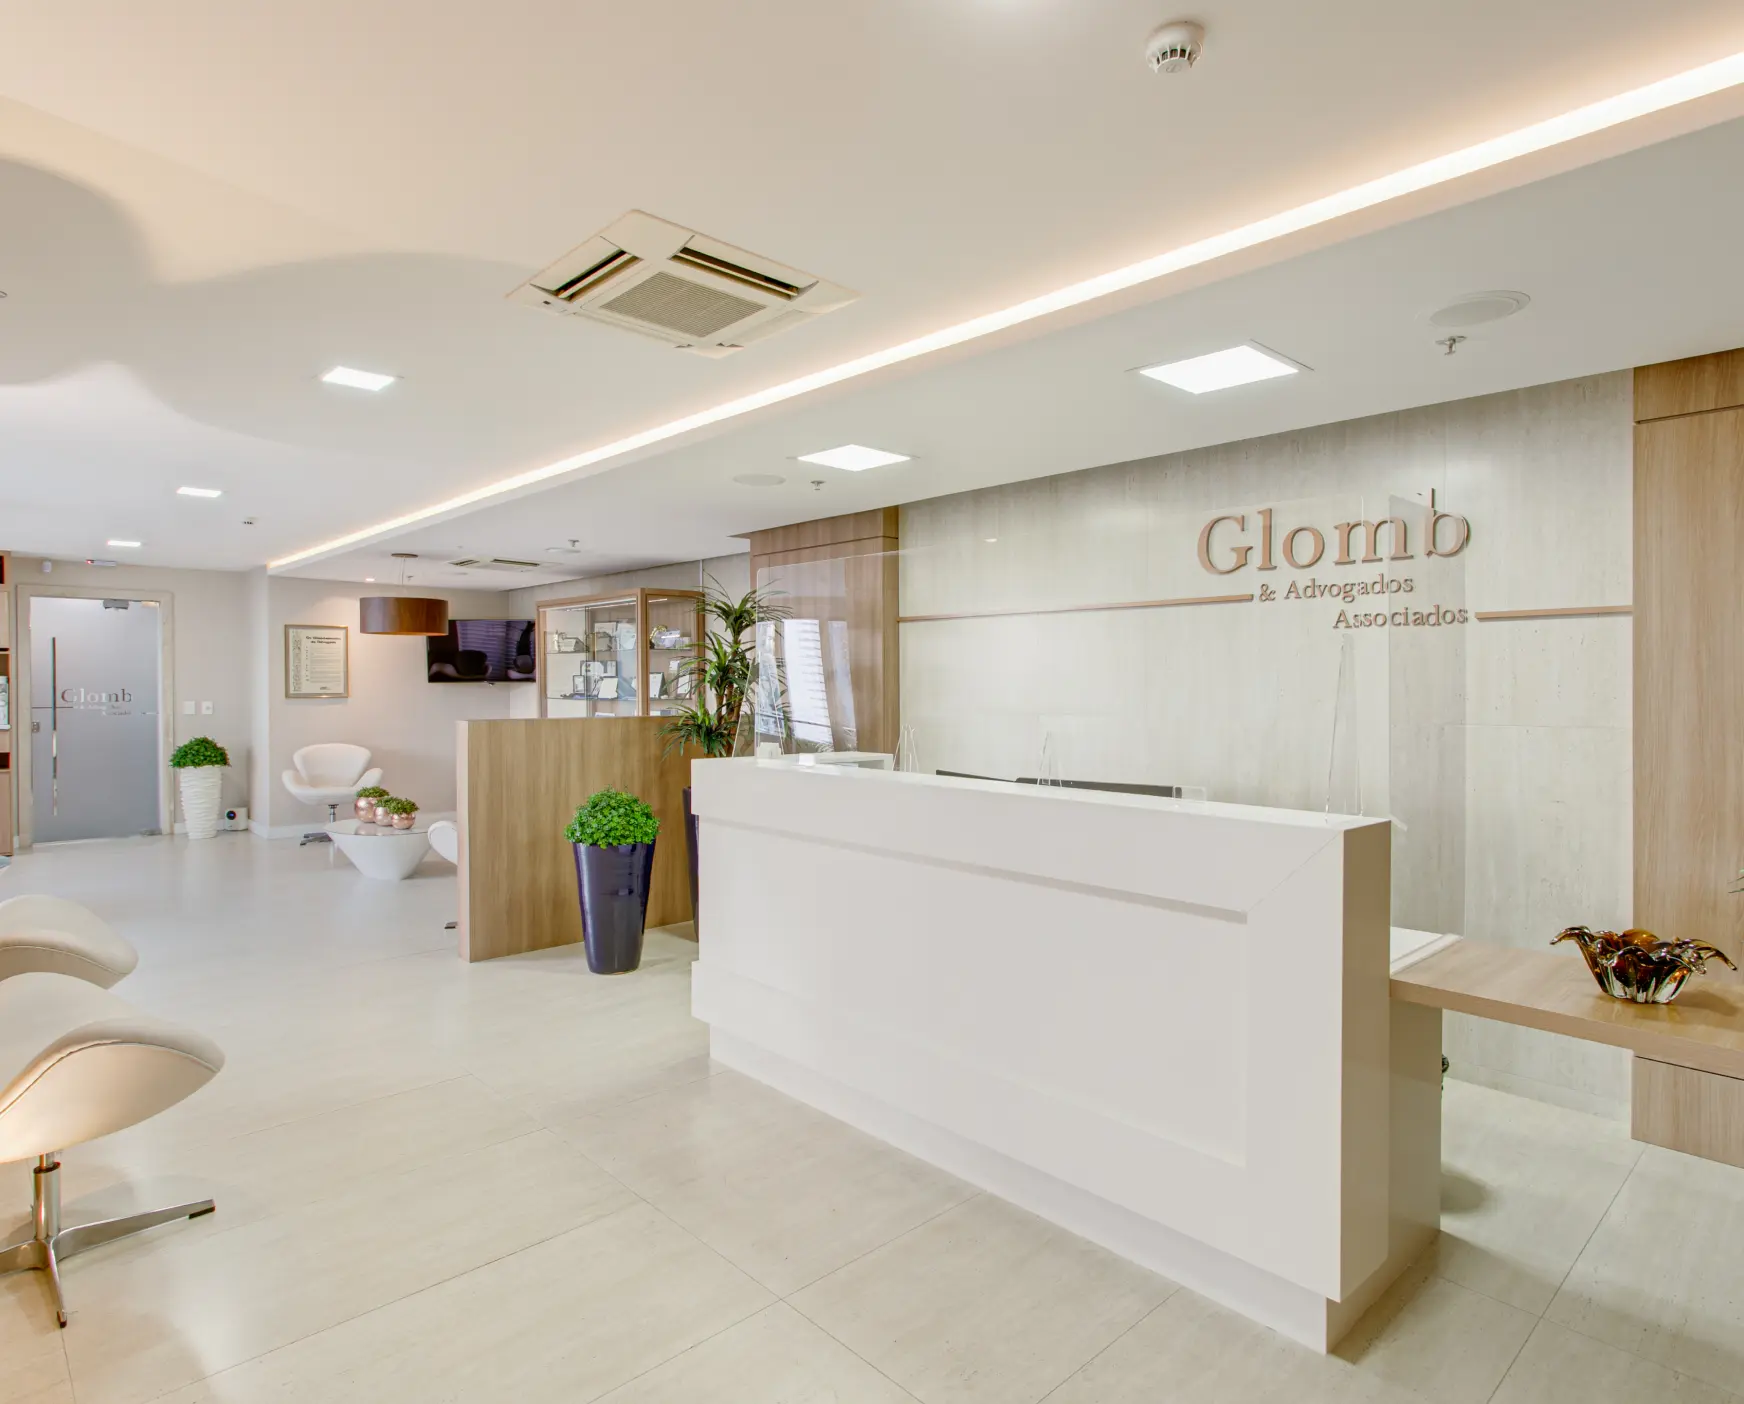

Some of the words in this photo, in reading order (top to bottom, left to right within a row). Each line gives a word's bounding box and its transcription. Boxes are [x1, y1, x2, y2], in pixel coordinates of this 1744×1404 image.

[1197, 488, 1471, 575] Glomb
[1258, 583, 1277, 602] &
[1284, 573, 1415, 603] Advogados
[1332, 604, 1469, 629] Associados
